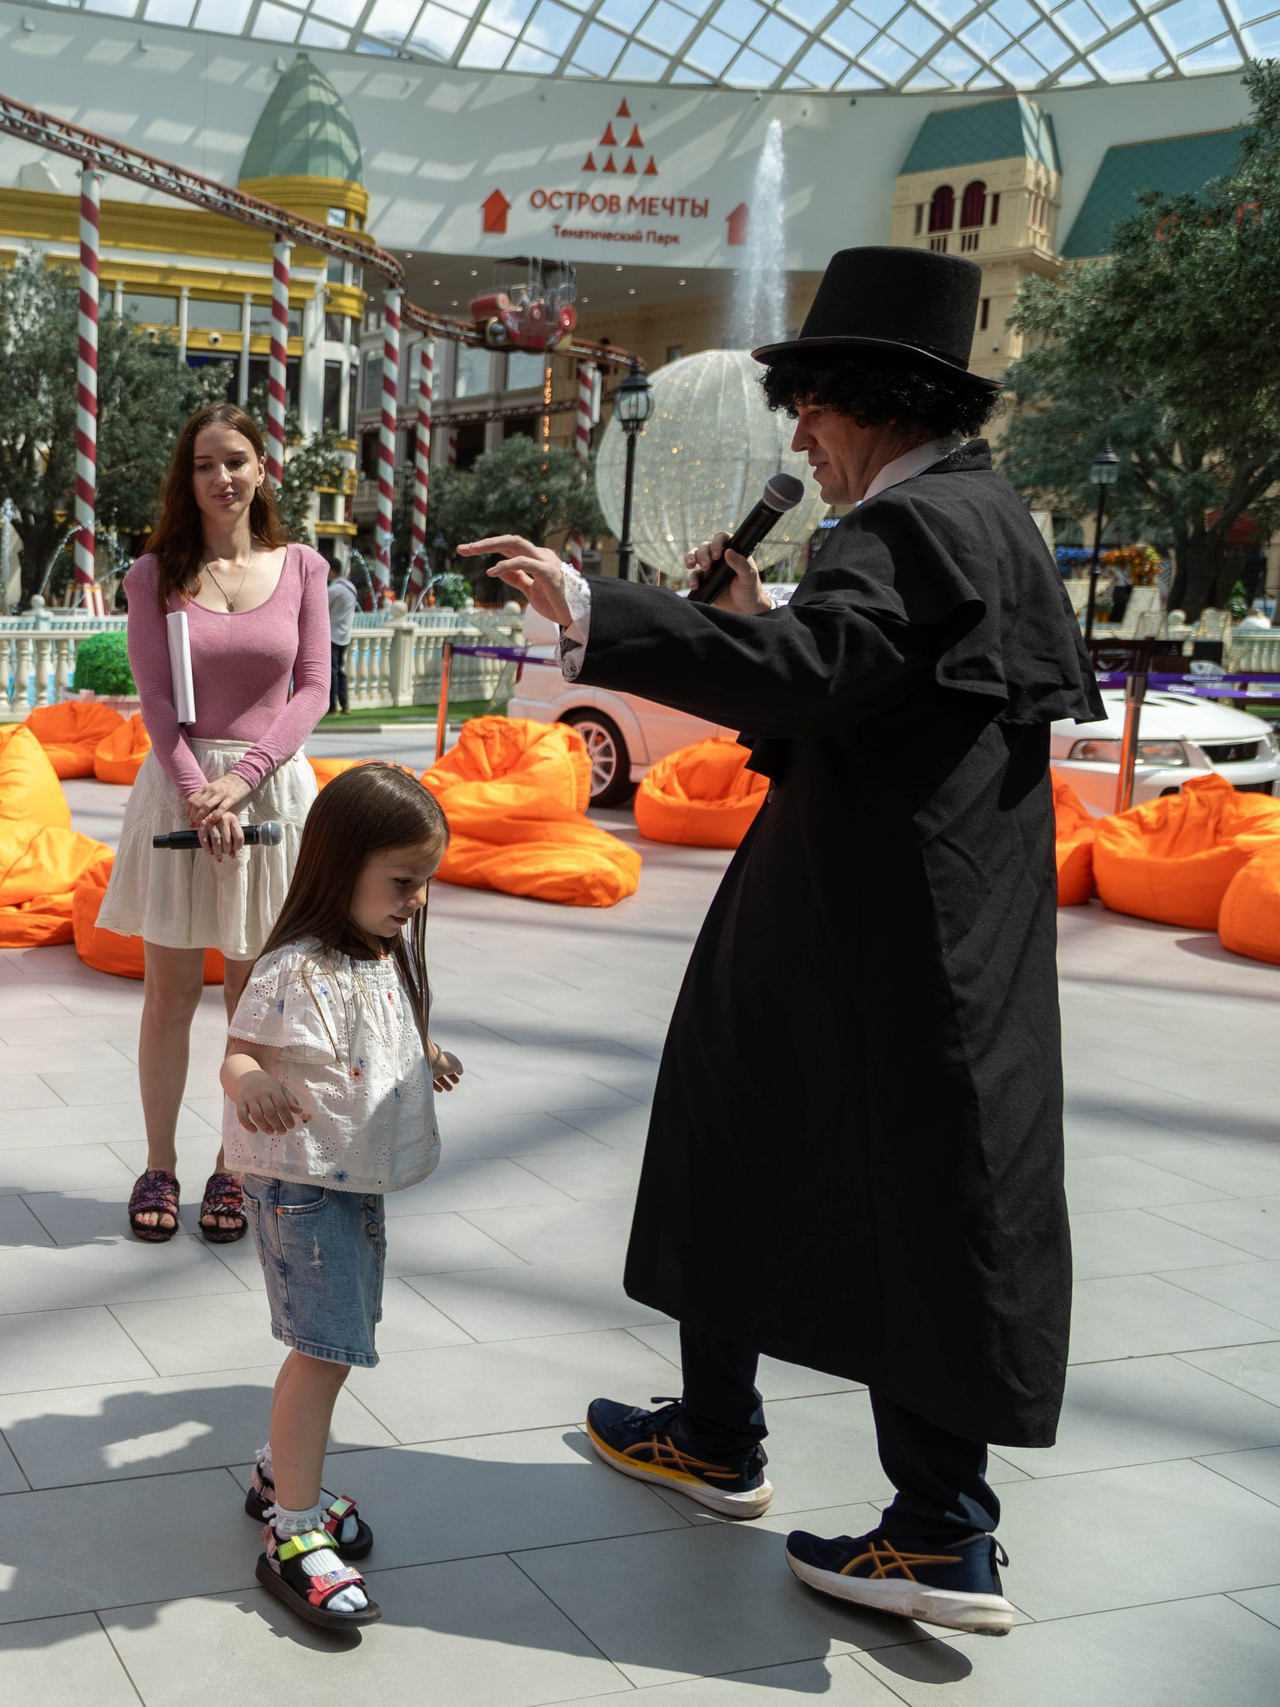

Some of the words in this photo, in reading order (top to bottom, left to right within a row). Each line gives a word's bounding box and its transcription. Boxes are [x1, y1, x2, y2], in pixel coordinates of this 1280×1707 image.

[529, 189, 621, 214] ОСТРОВ
[627, 196, 709, 218] МЕЧТЫ
[553, 225, 643, 244] Тематический
[646, 231, 681, 247] Парк
